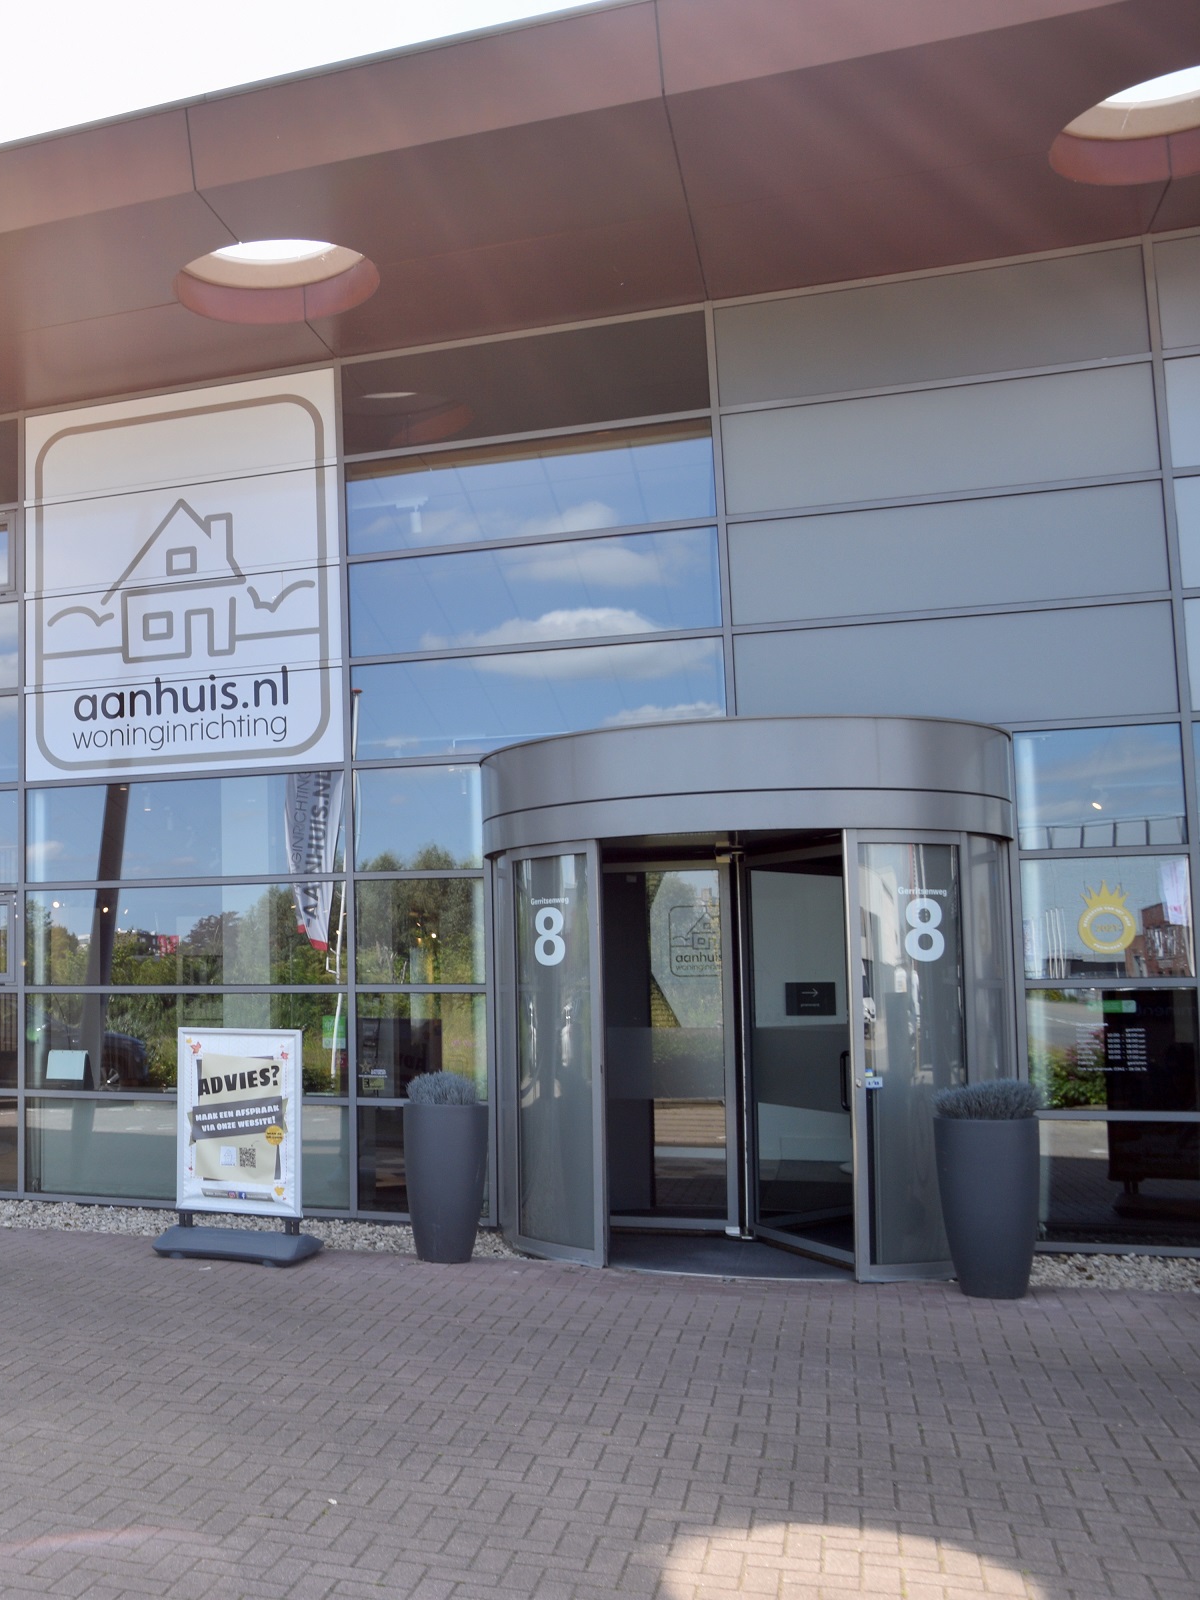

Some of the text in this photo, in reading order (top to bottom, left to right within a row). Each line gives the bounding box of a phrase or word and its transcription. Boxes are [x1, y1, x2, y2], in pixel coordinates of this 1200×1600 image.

[73, 665, 289, 722] aanhuis.nl
[72, 713, 287, 751] woninginrichting
[530, 897, 569, 905] Gerritsenweg
[897, 886, 948, 897] Gerritsenweg
[534, 906, 566, 967] 8
[905, 897, 945, 963] 8
[198, 1065, 280, 1096] ADVIES?
[195, 1104, 280, 1121] MAAK EEN AFSPRAAK
[201, 1116, 276, 1132] VIA ONZE WEBSITE!
